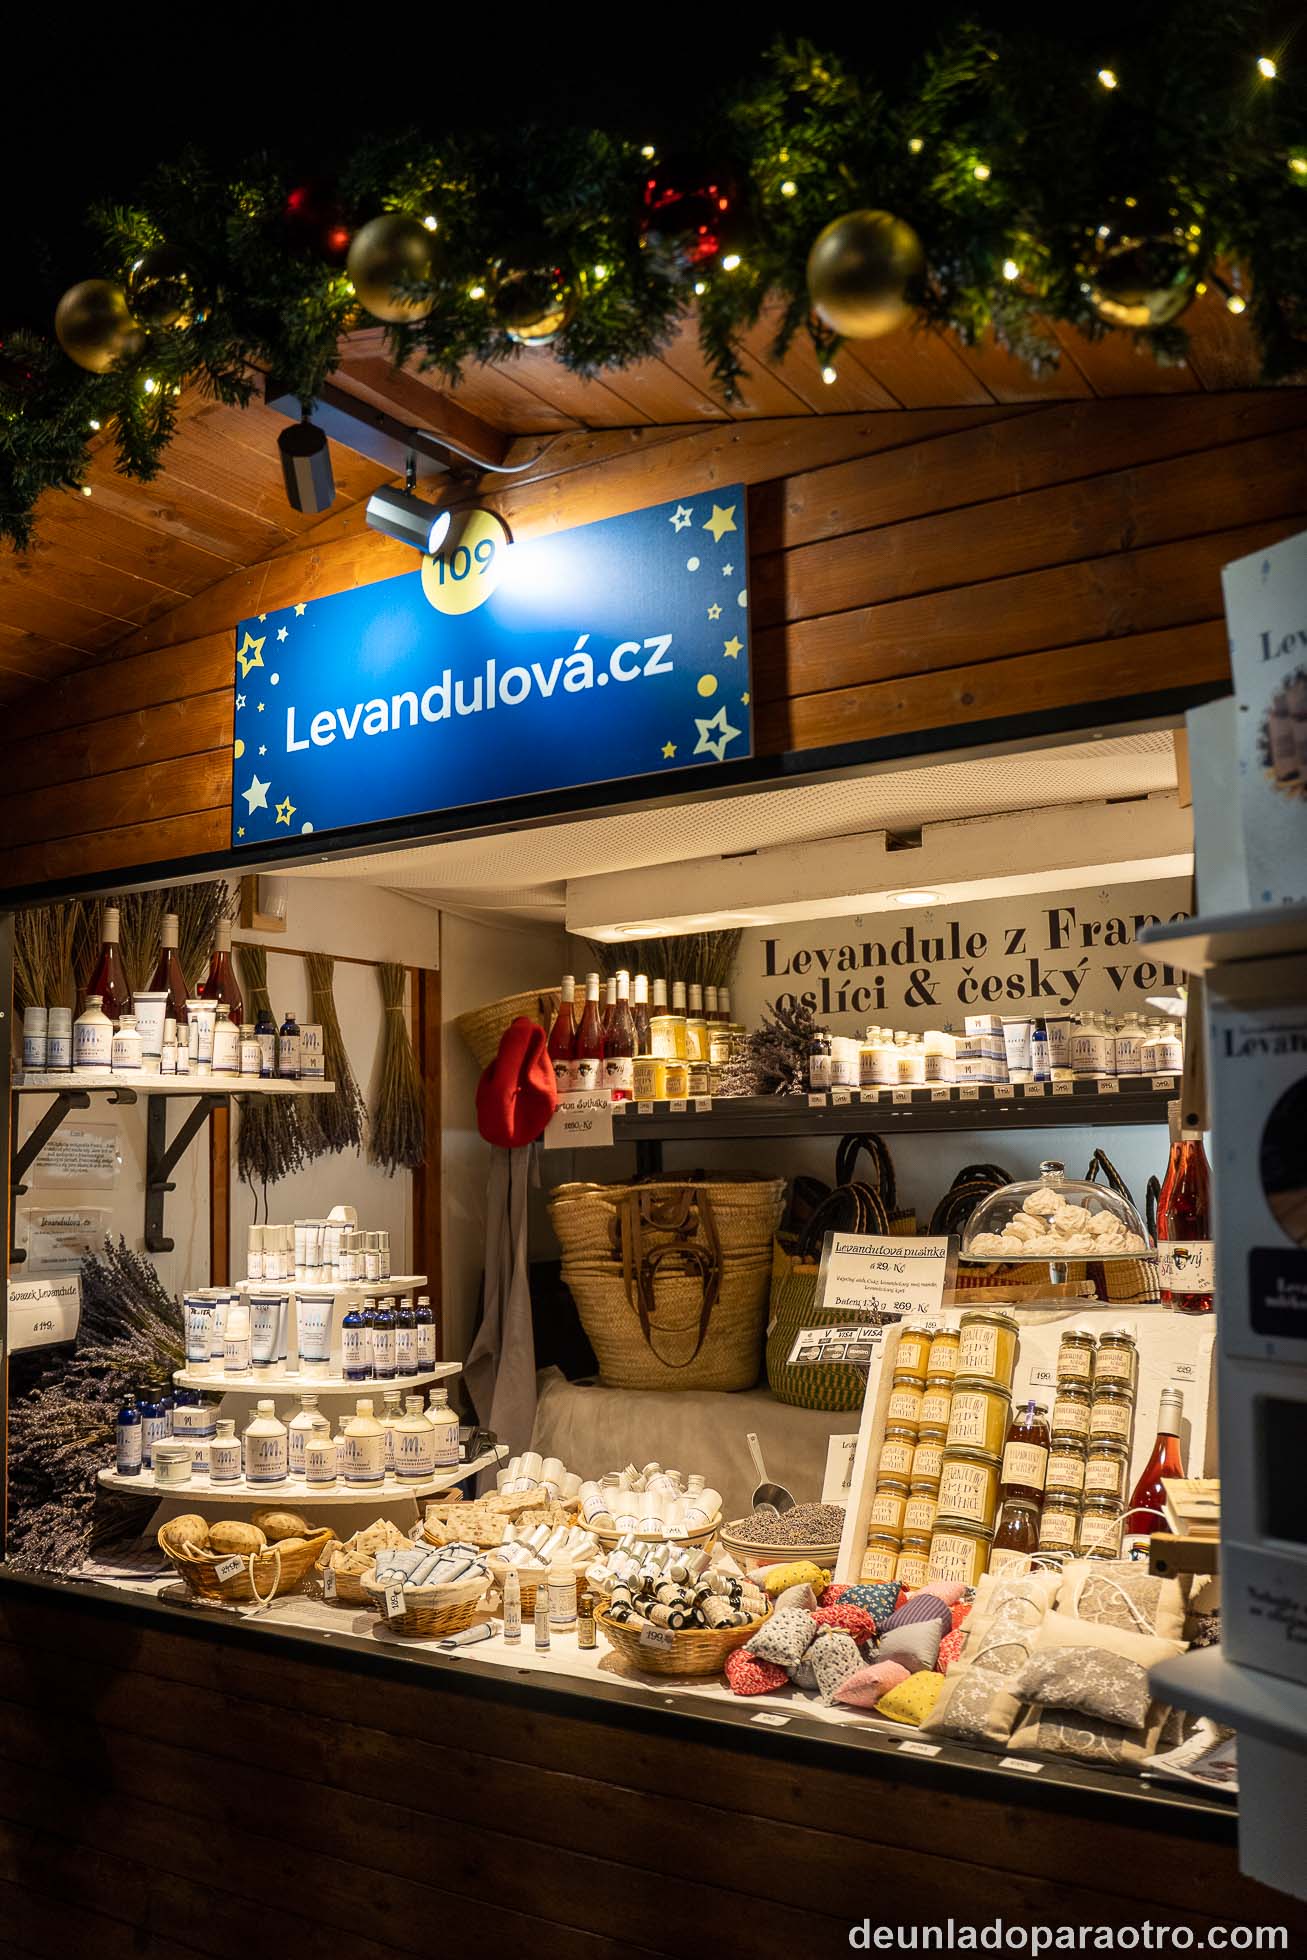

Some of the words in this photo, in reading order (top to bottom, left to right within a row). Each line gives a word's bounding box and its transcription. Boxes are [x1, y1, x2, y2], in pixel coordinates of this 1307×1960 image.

[432, 538, 496, 586] 109
[286, 632, 674, 753] Levandulová.cz
[760, 921, 988, 977] Levandule
[1004, 928, 1026, 956] z
[904, 968, 941, 1008] &
[957, 956, 1089, 1006] český
[863, 1329, 883, 1337] VISA
